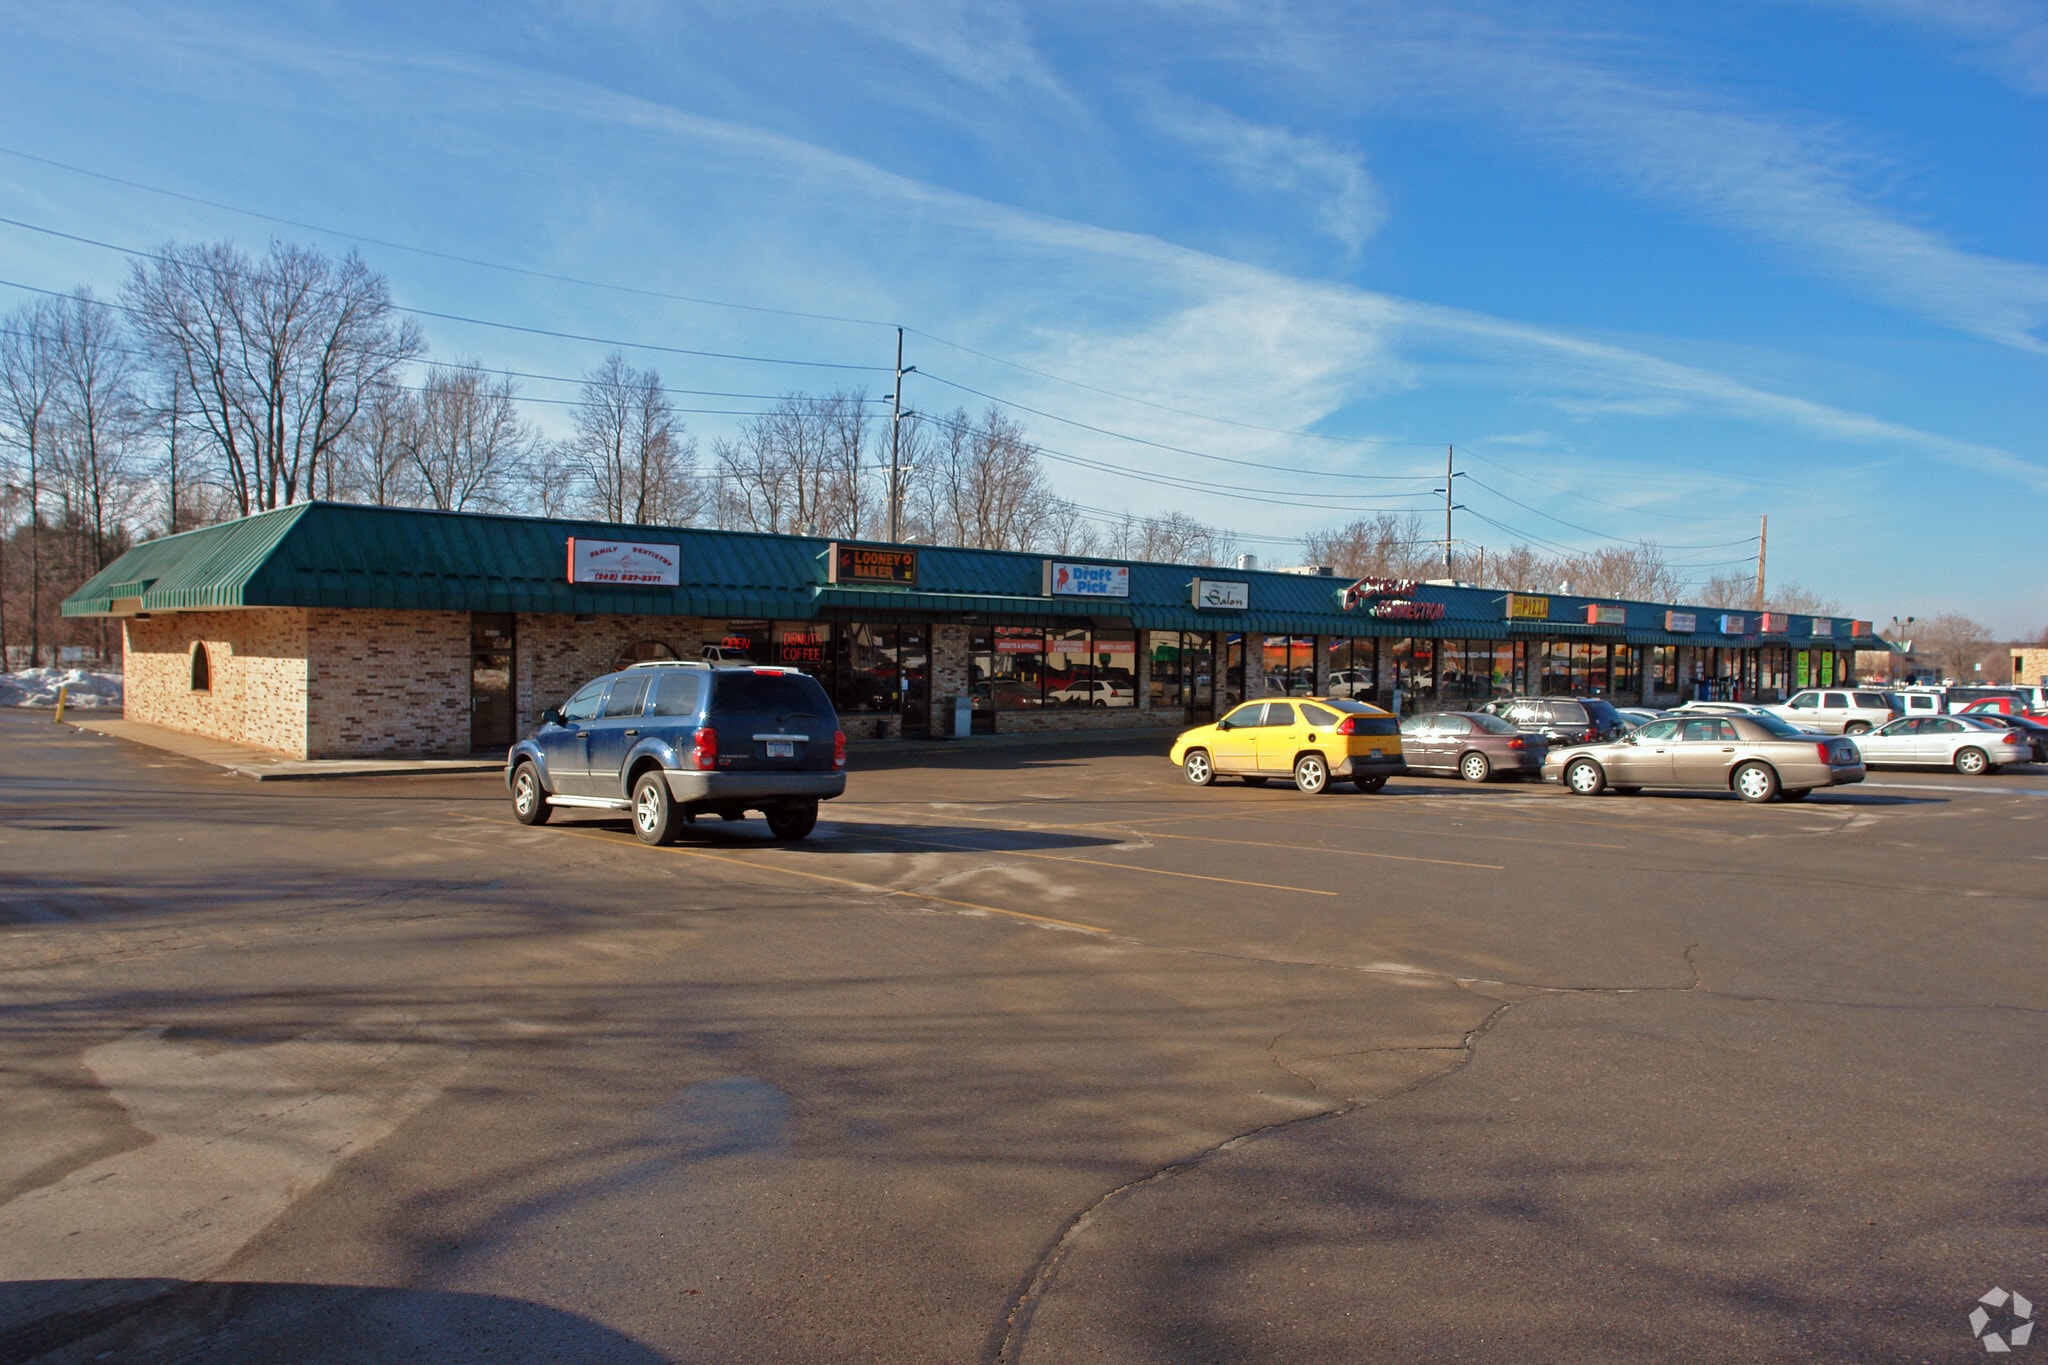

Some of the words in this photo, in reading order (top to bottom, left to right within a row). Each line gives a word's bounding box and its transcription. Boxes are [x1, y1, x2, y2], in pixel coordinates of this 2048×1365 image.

[590, 546, 618, 558] FAMILY
[632, 547, 673, 567] DENTISTRY
[854, 551, 901, 566] LOONEY
[854, 564, 895, 580] BAKER
[1073, 567, 1112, 581] Draft
[1077, 580, 1108, 593] Pick
[1204, 589, 1243, 606] Salon
[1377, 600, 1445, 620] CONNECTION
[1522, 598, 1547, 616] PIZZA
[721, 637, 750, 650] OPEN
[783, 632, 823, 646] DONUTS
[783, 648, 821, 661] COFFEE
